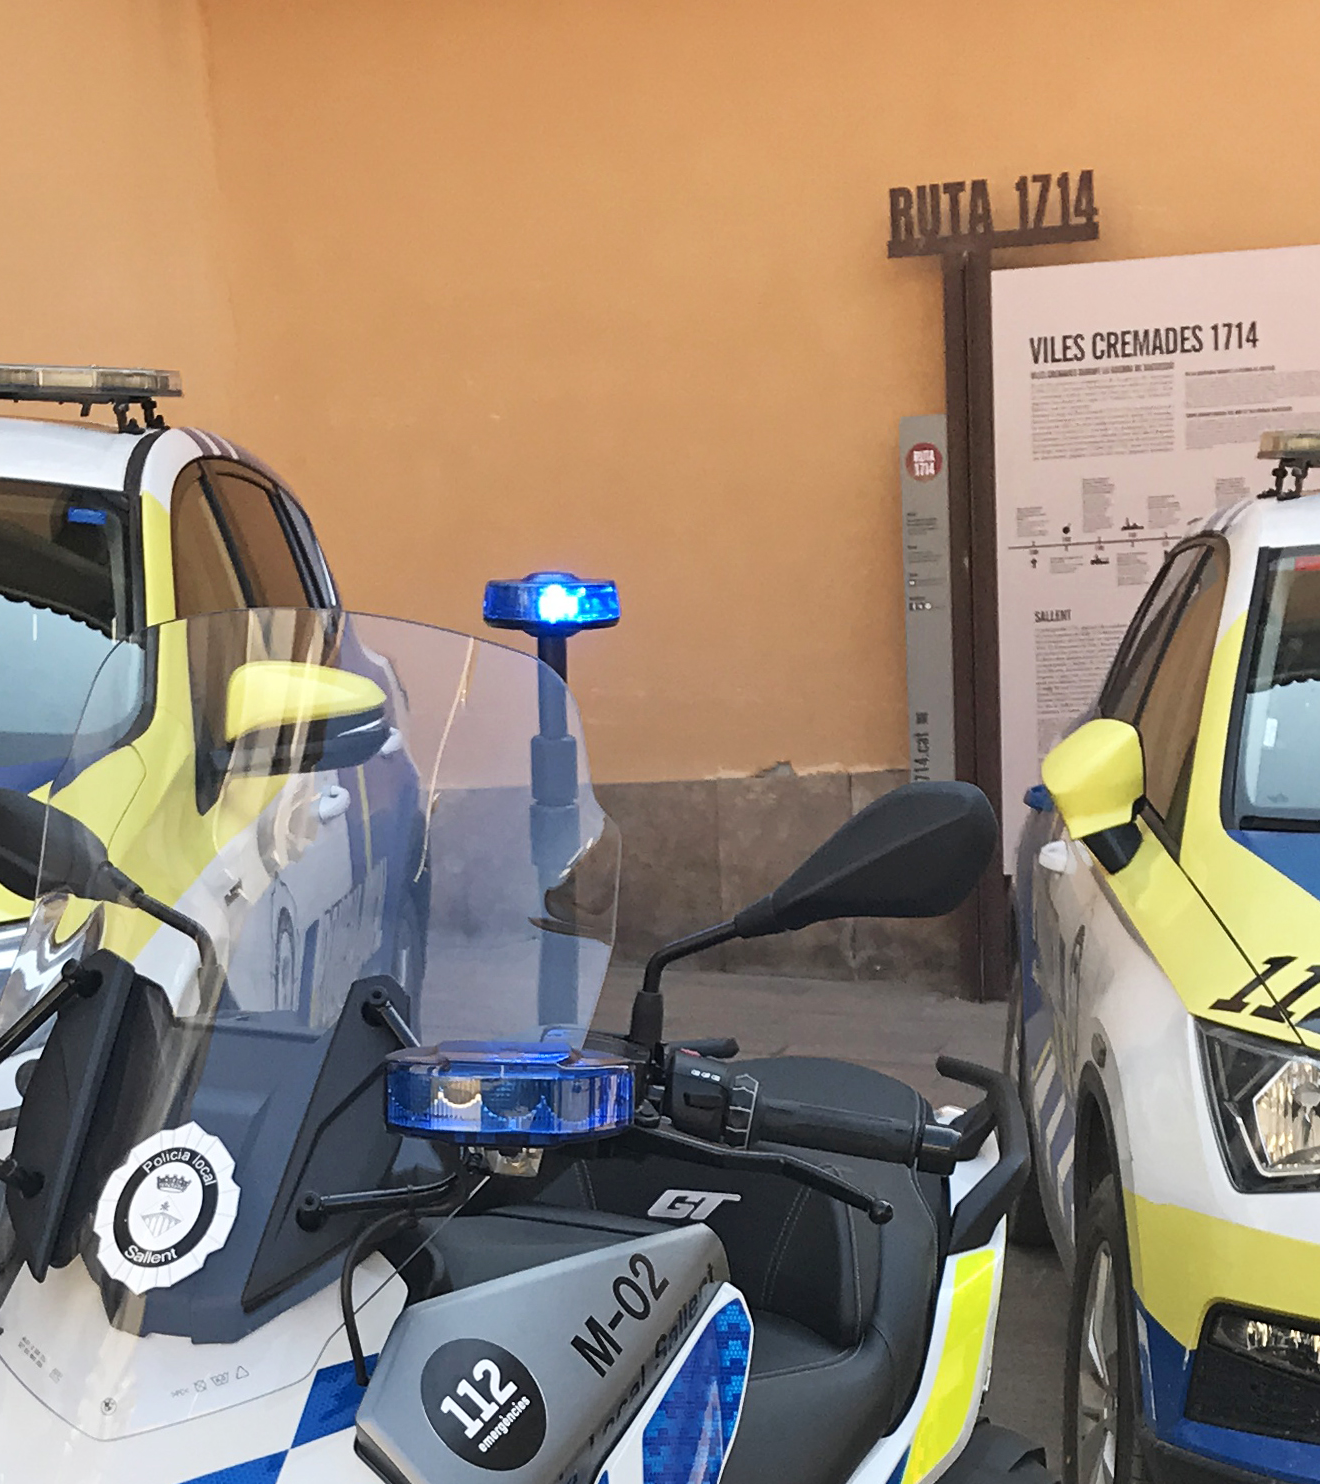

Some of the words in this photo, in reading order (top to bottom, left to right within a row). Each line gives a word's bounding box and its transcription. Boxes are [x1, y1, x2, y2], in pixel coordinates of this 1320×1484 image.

[889, 179, 993, 241] RUTA
[1015, 169, 1099, 231] 1714
[1029, 333, 1086, 364] VILES
[1091, 324, 1204, 360] CREMADES
[1211, 321, 1260, 352] 1714
[1034, 609, 1072, 623] SALLENT
[192, 1154, 218, 1186] local
[647, 1189, 742, 1220] GT
[124, 1244, 178, 1264] Sallent
[570, 1252, 670, 1378] M-02
[440, 1358, 518, 1440] 112
